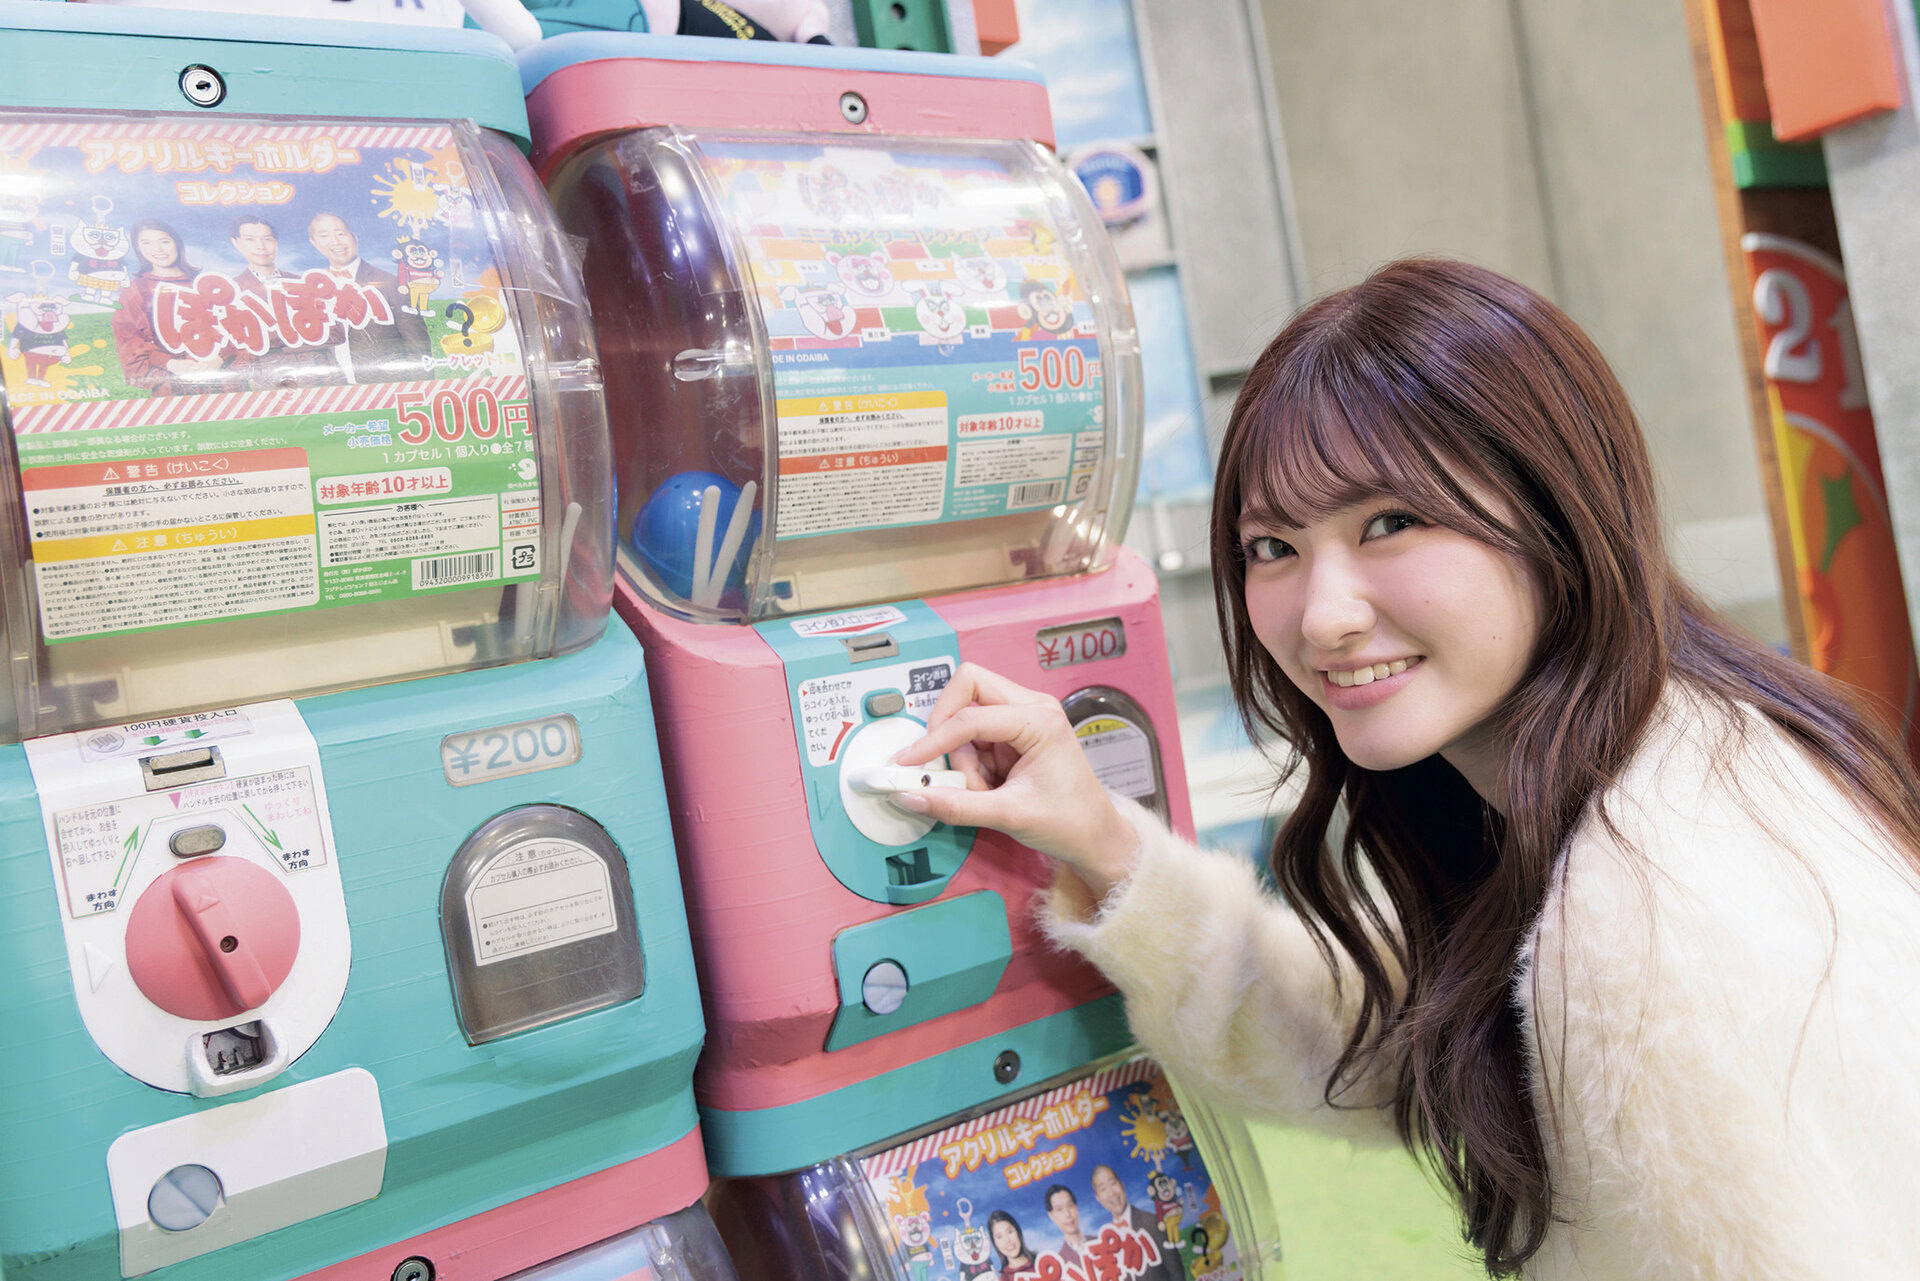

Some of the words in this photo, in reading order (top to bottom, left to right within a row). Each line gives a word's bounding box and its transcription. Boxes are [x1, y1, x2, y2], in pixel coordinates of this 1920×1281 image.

[83, 138, 360, 172] アクリルキーホルダー
[178, 182, 294, 204] コレクション
[153, 269, 394, 361] ぽかぽか
[786, 354, 795, 363] IN
[796, 352, 829, 363] ODAIBA
[40, 391, 54, 400] IN
[57, 388, 111, 401] ODAIBA
[323, 419, 390, 436] メーカー希望
[958, 416, 1042, 433] 対象年齢10才以上
[347, 434, 392, 449] 小売価格
[320, 474, 450, 500] 対象年齢10才以上
[518, 550, 535, 564] プラ
[1038, 629, 1117, 666] ¥100
[123, 709, 238, 733] 100円硬貨投入口
[808, 727, 828, 738] てくだ
[446, 722, 567, 775] ¥200
[59, 805, 122, 824] ハンドルを元の位置に
[282, 849, 311, 861] まわす
[288, 859, 309, 870] 方向
[86, 889, 118, 903] まわす
[92, 900, 116, 912] 方向
[939, 1090, 1109, 1180] アクリルキーホルダー
[1003, 1144, 1077, 1190] コレクション
